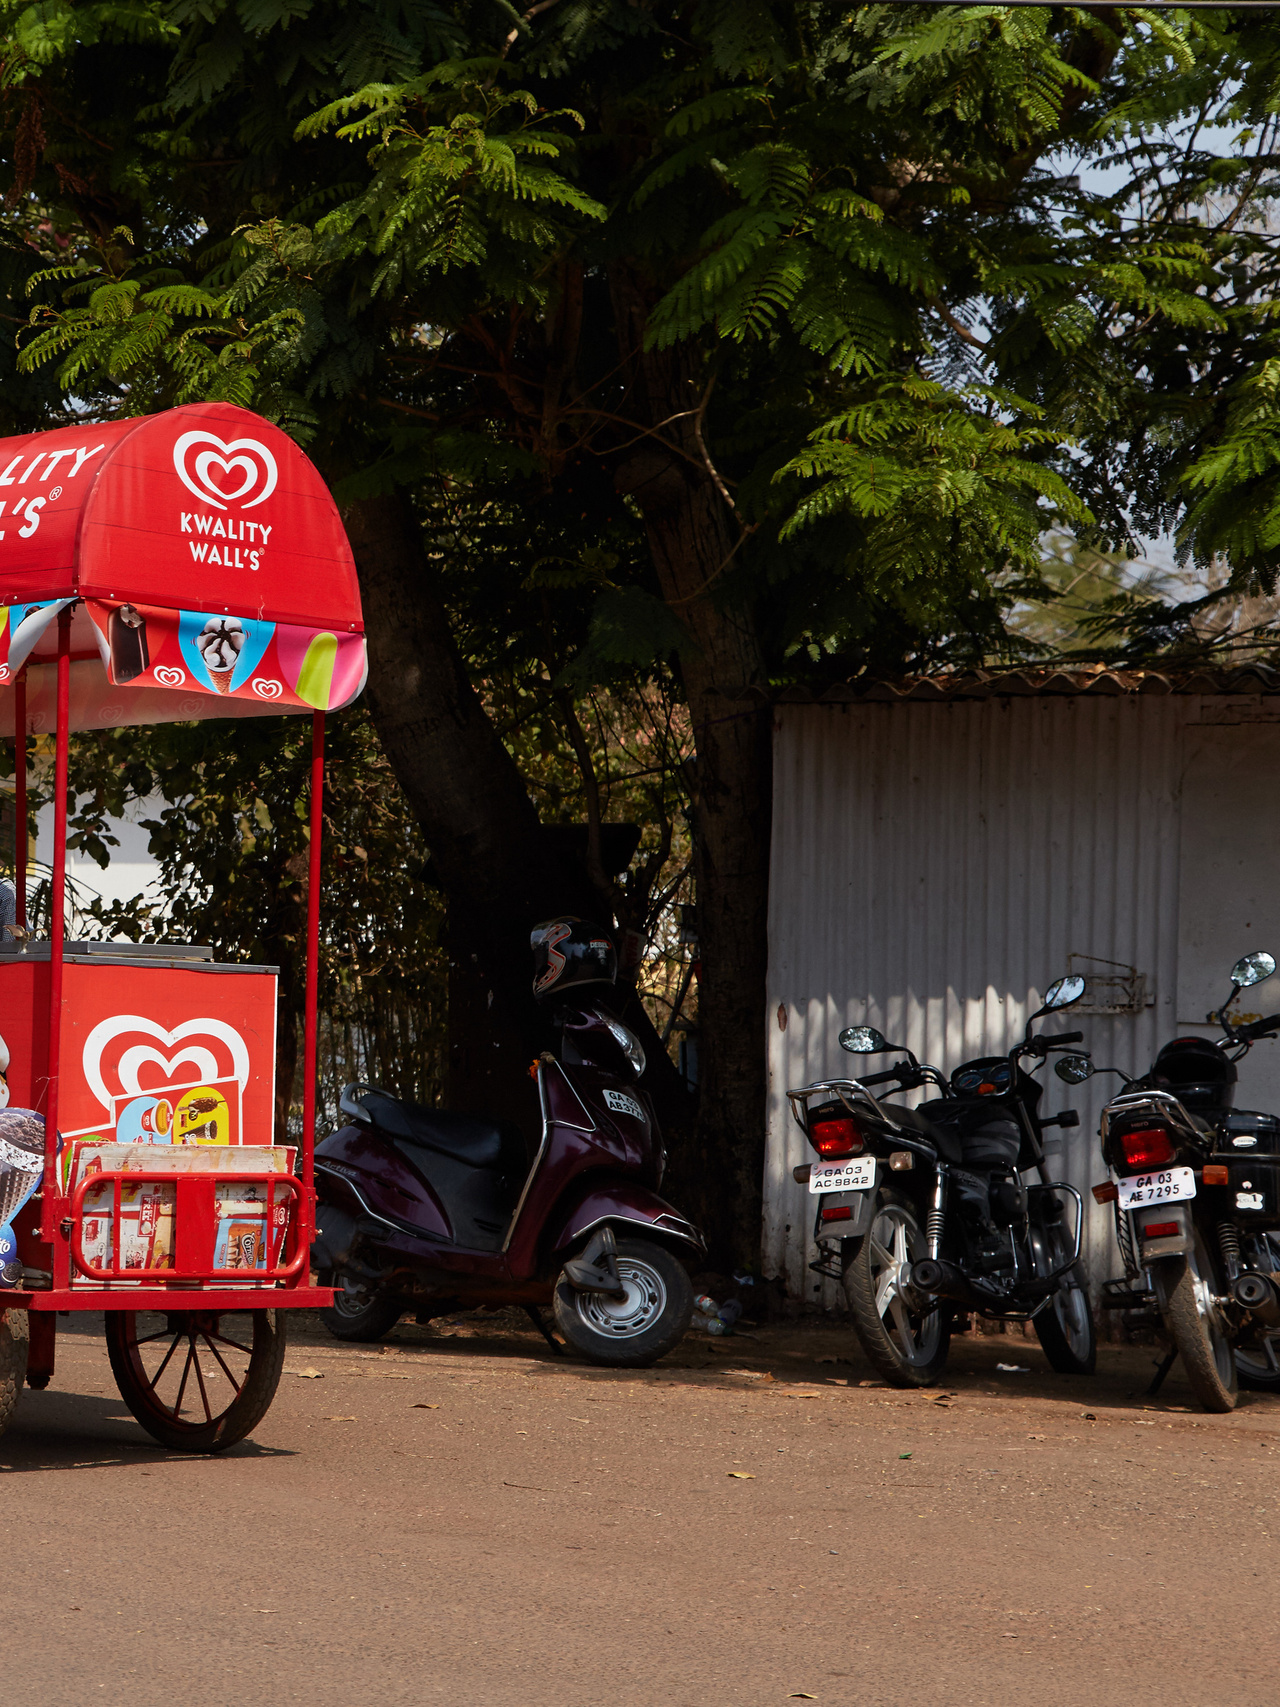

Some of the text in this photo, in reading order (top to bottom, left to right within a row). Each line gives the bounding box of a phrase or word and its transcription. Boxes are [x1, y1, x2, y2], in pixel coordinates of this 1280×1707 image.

[180, 511, 273, 545] KWALITY
[608, 1091, 625, 1102] GA
[321, 1160, 358, 1177] Activa
[1136, 1172, 1172, 1188] GA 03
[1129, 1183, 1180, 1203] AE 7295
[142, 1197, 151, 1221] FREE
